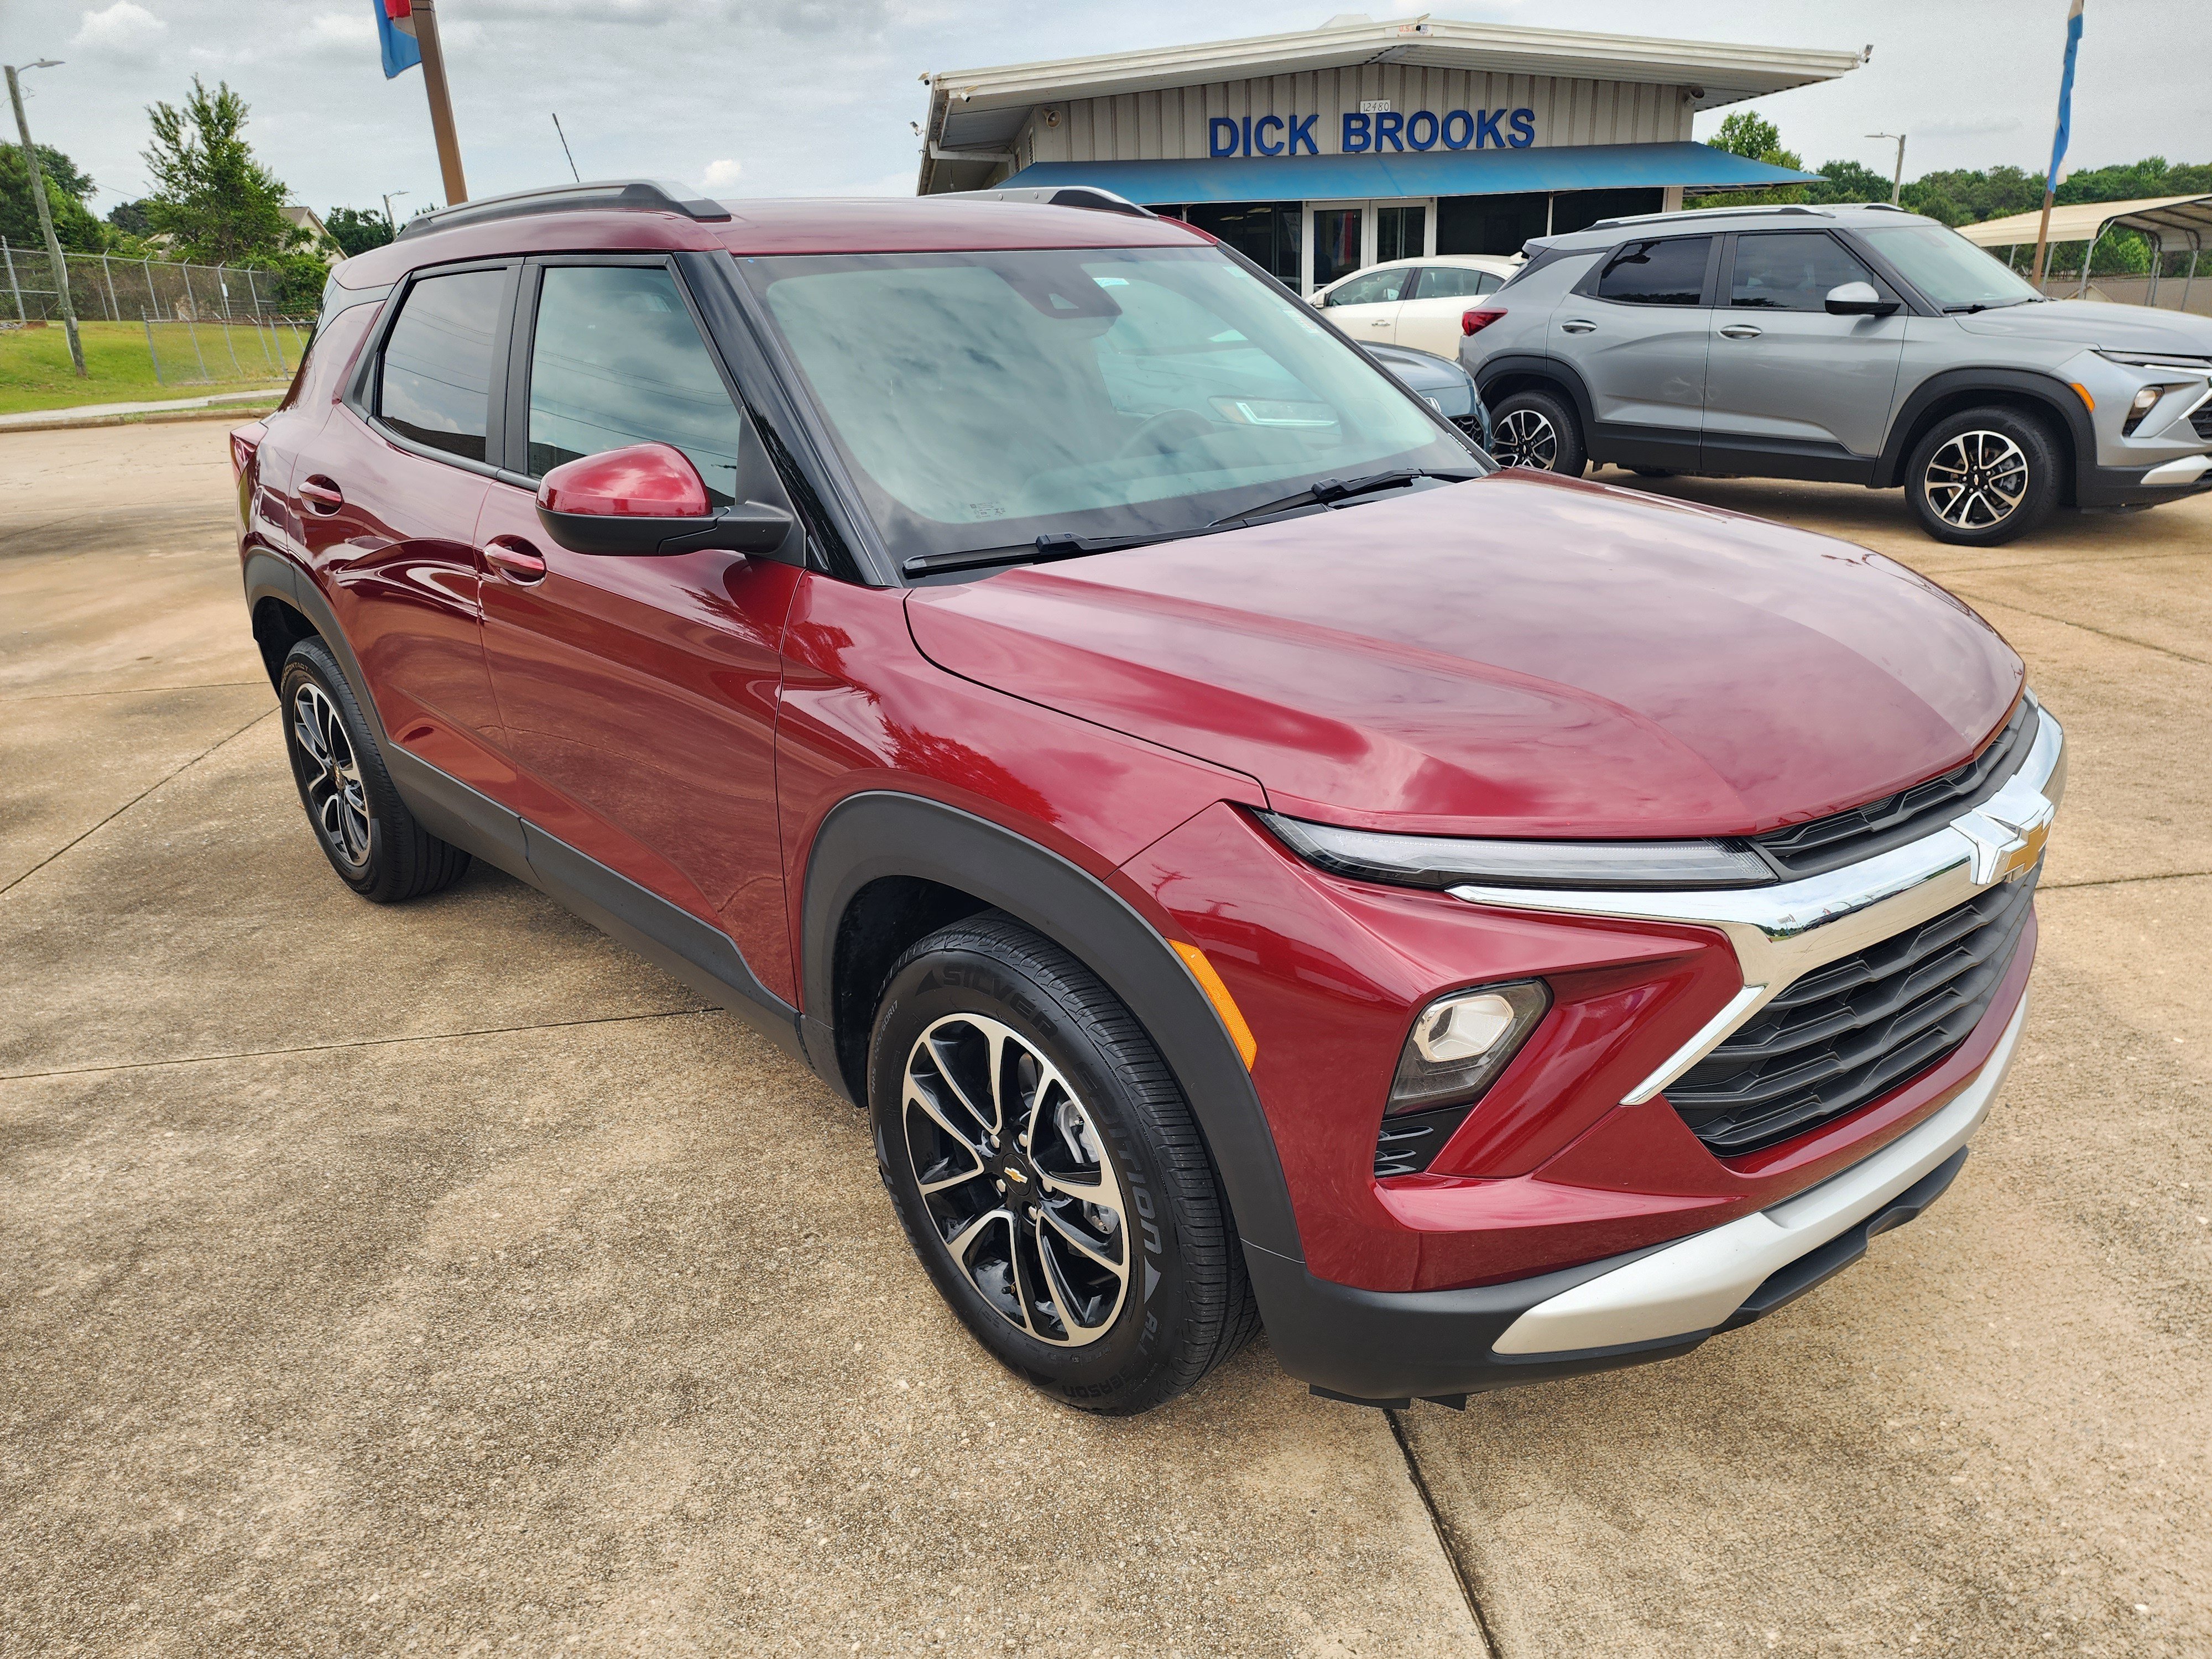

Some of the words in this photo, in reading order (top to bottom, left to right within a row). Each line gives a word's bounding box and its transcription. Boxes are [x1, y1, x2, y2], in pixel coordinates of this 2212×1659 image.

[1363, 102, 1389, 112] 12480
[1209, 114, 1319, 157] DICK
[1343, 108, 1535, 152] BROOKS
[942, 964, 1060, 1041] SILVER
[1139, 1310, 1158, 1355] ALL
